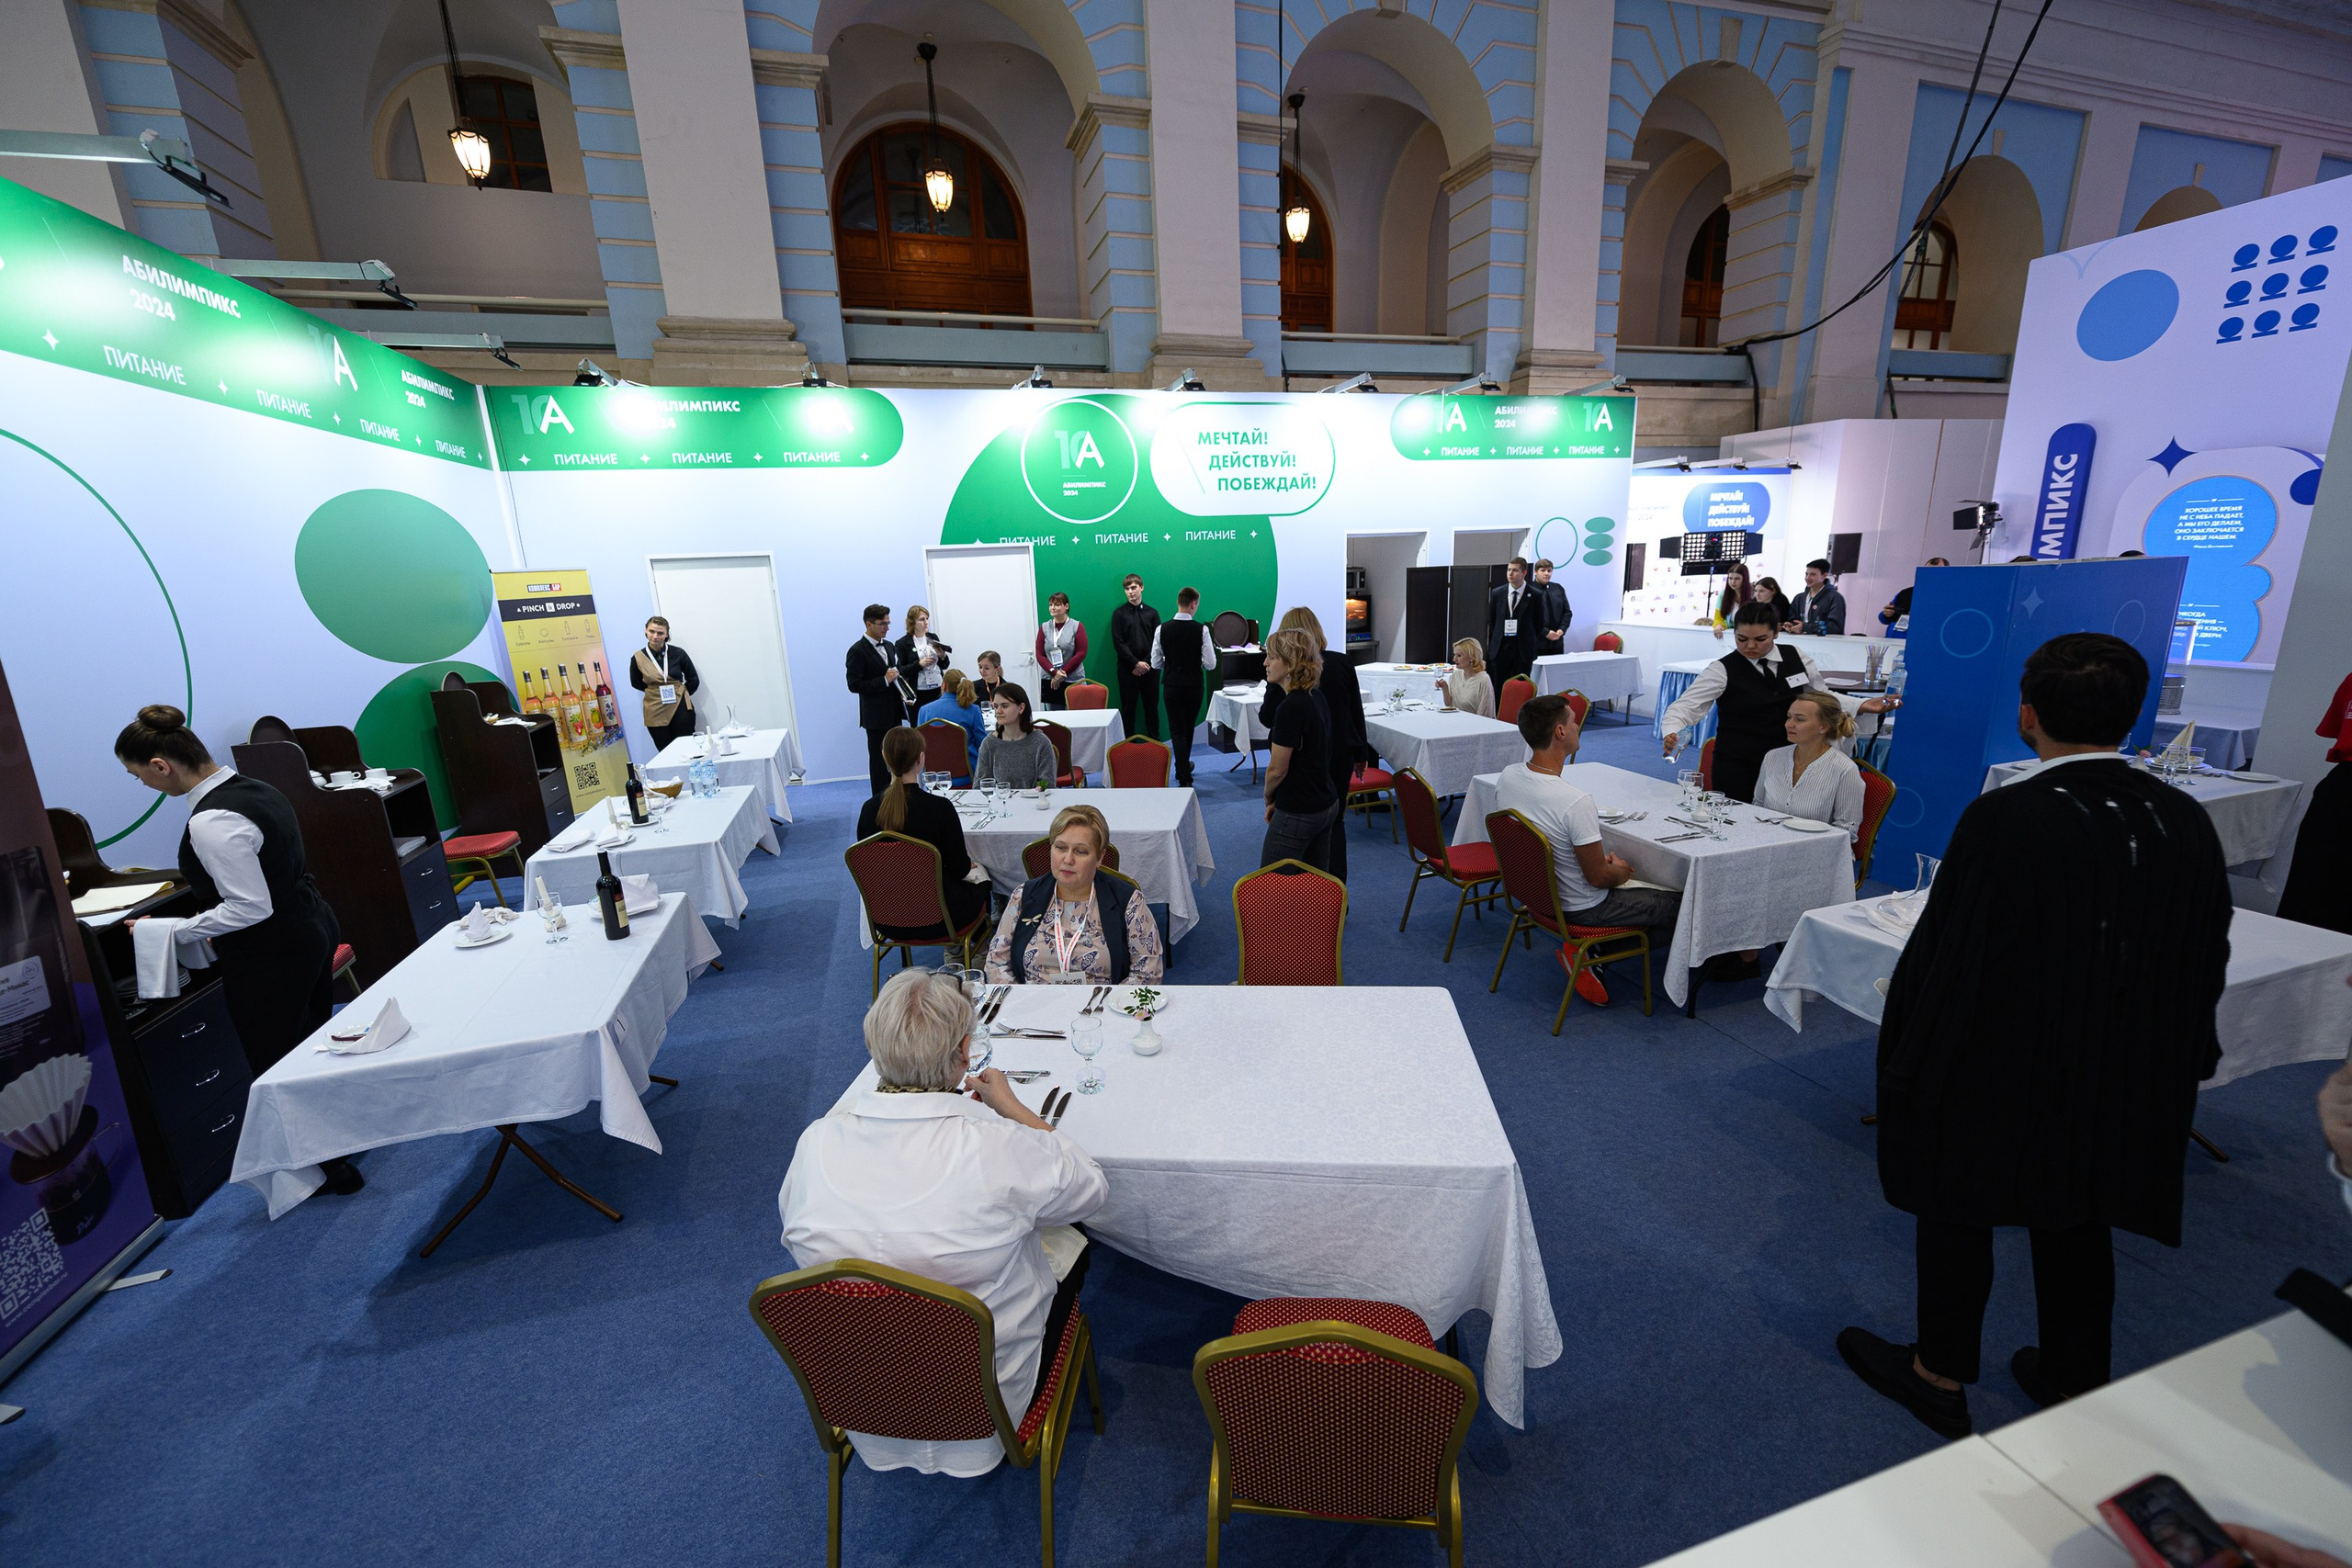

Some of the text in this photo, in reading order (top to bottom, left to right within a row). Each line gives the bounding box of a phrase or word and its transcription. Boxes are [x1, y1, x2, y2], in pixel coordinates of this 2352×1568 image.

[122, 254, 241, 319] АБИЛИМПИКС
[129, 288, 175, 321] 2024
[401, 369, 455, 400] АБИЛИМПИКС
[103, 344, 467, 458] ПИТАНИЕ ПИТАНИЕ ПИТАНИЕ ПИТАНИЕ
[646, 400, 741, 412] ИЛИМПИКС
[1494, 419, 1517, 429] 2024
[1198, 427, 1268, 446] МЕЧТАЙ!
[553, 451, 841, 466] ПИТАНИЕ ПИТАНИЕ ПИТАНИЕ
[1441, 446, 1605, 457] ПИТАНИЕ ПИТАНИЕ ПИТАНИЕ
[1208, 450, 1296, 470] ДЕЙСТВУЙ!
[1217, 472, 1317, 492] ПОБЕЖДАЙ!
[1709, 490, 1744, 502] МЕЧТАЙ!
[1708, 502, 1750, 516] ДЕЙСТВУЙ!
[2038, 453, 2079, 558] МПИКС
[1707, 516, 1755, 528] ПОБЕЖДАЙ!
[1094, 532, 1148, 544] ПИТАНИЕ
[1185, 530, 1237, 541] ПИТАНИЕ
[522, 604, 545, 614] PINCH
